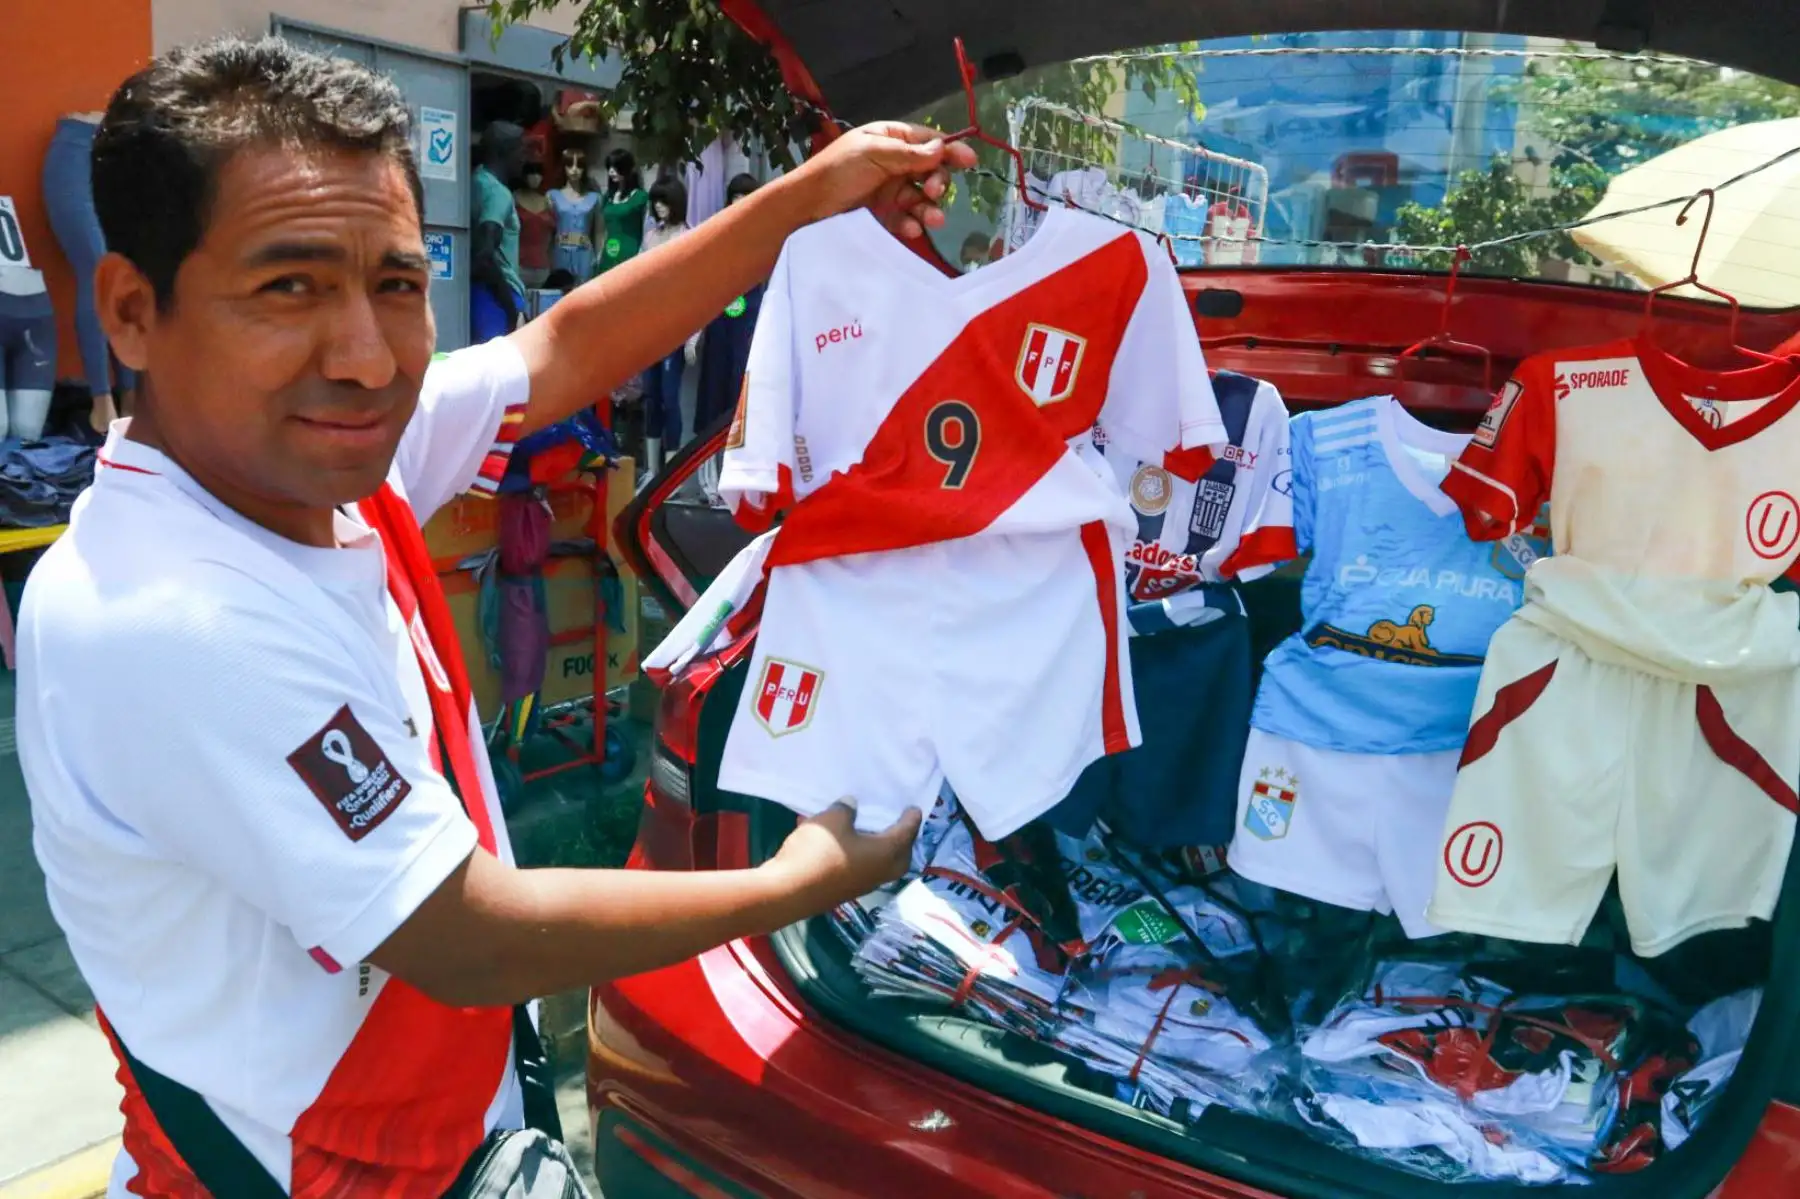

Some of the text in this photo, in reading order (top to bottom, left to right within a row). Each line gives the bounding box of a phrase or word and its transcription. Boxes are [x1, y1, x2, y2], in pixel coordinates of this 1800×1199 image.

[816, 318, 862, 354] perú
[1570, 369, 1629, 389] SPORADE
[924, 400, 981, 490] 9
[766, 682, 809, 706] PERU
[1461, 833, 1494, 876] U
